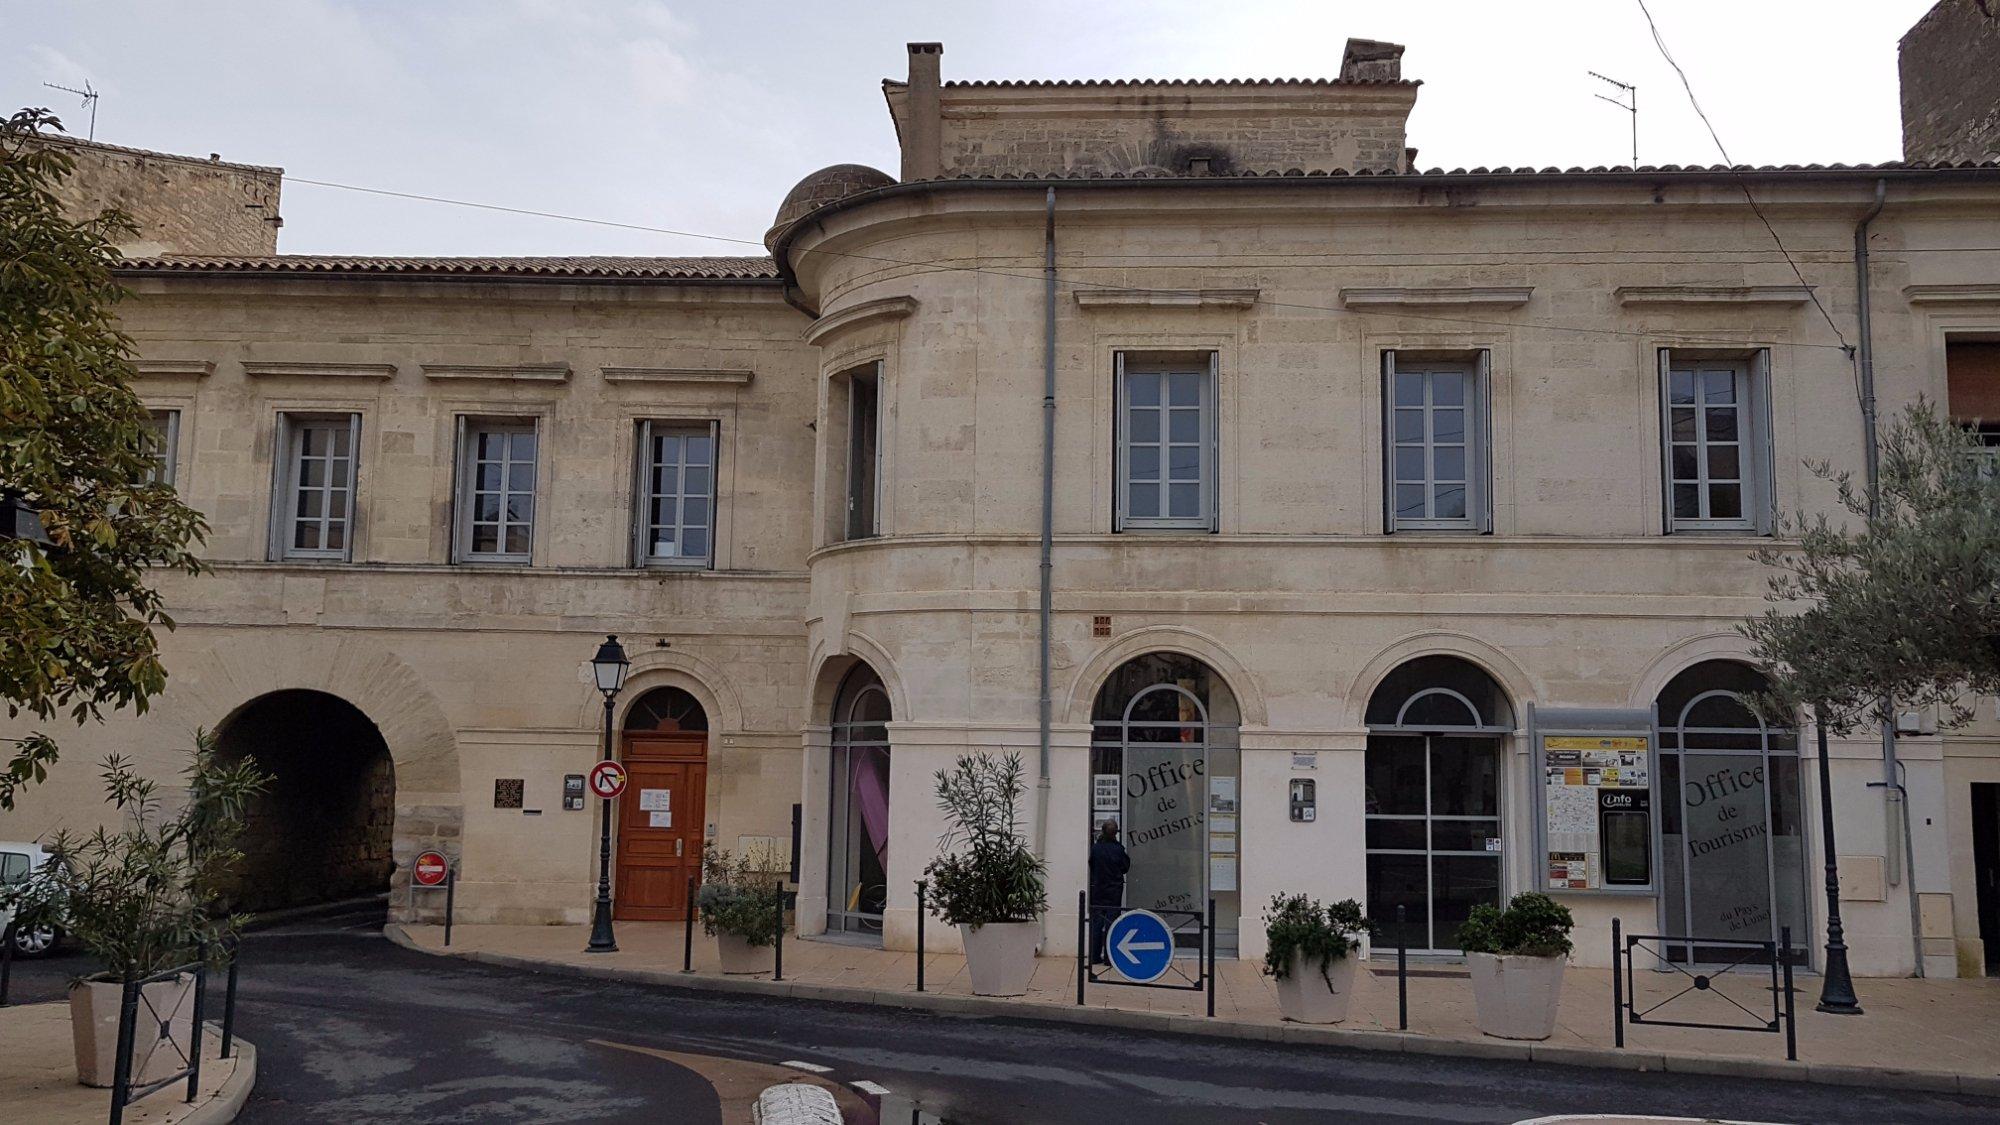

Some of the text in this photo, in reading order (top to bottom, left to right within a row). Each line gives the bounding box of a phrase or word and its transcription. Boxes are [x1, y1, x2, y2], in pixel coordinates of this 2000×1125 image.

[1127, 759, 1204, 798] Office
[1686, 767, 1764, 807] Office
[1158, 797, 1177, 812] de
[1718, 806, 1738, 821] de
[1127, 812, 1204, 847] Tourisme
[1154, 899, 1167, 909] du
[1720, 904, 1759, 921] du Pays
[1729, 919, 1742, 931] de
